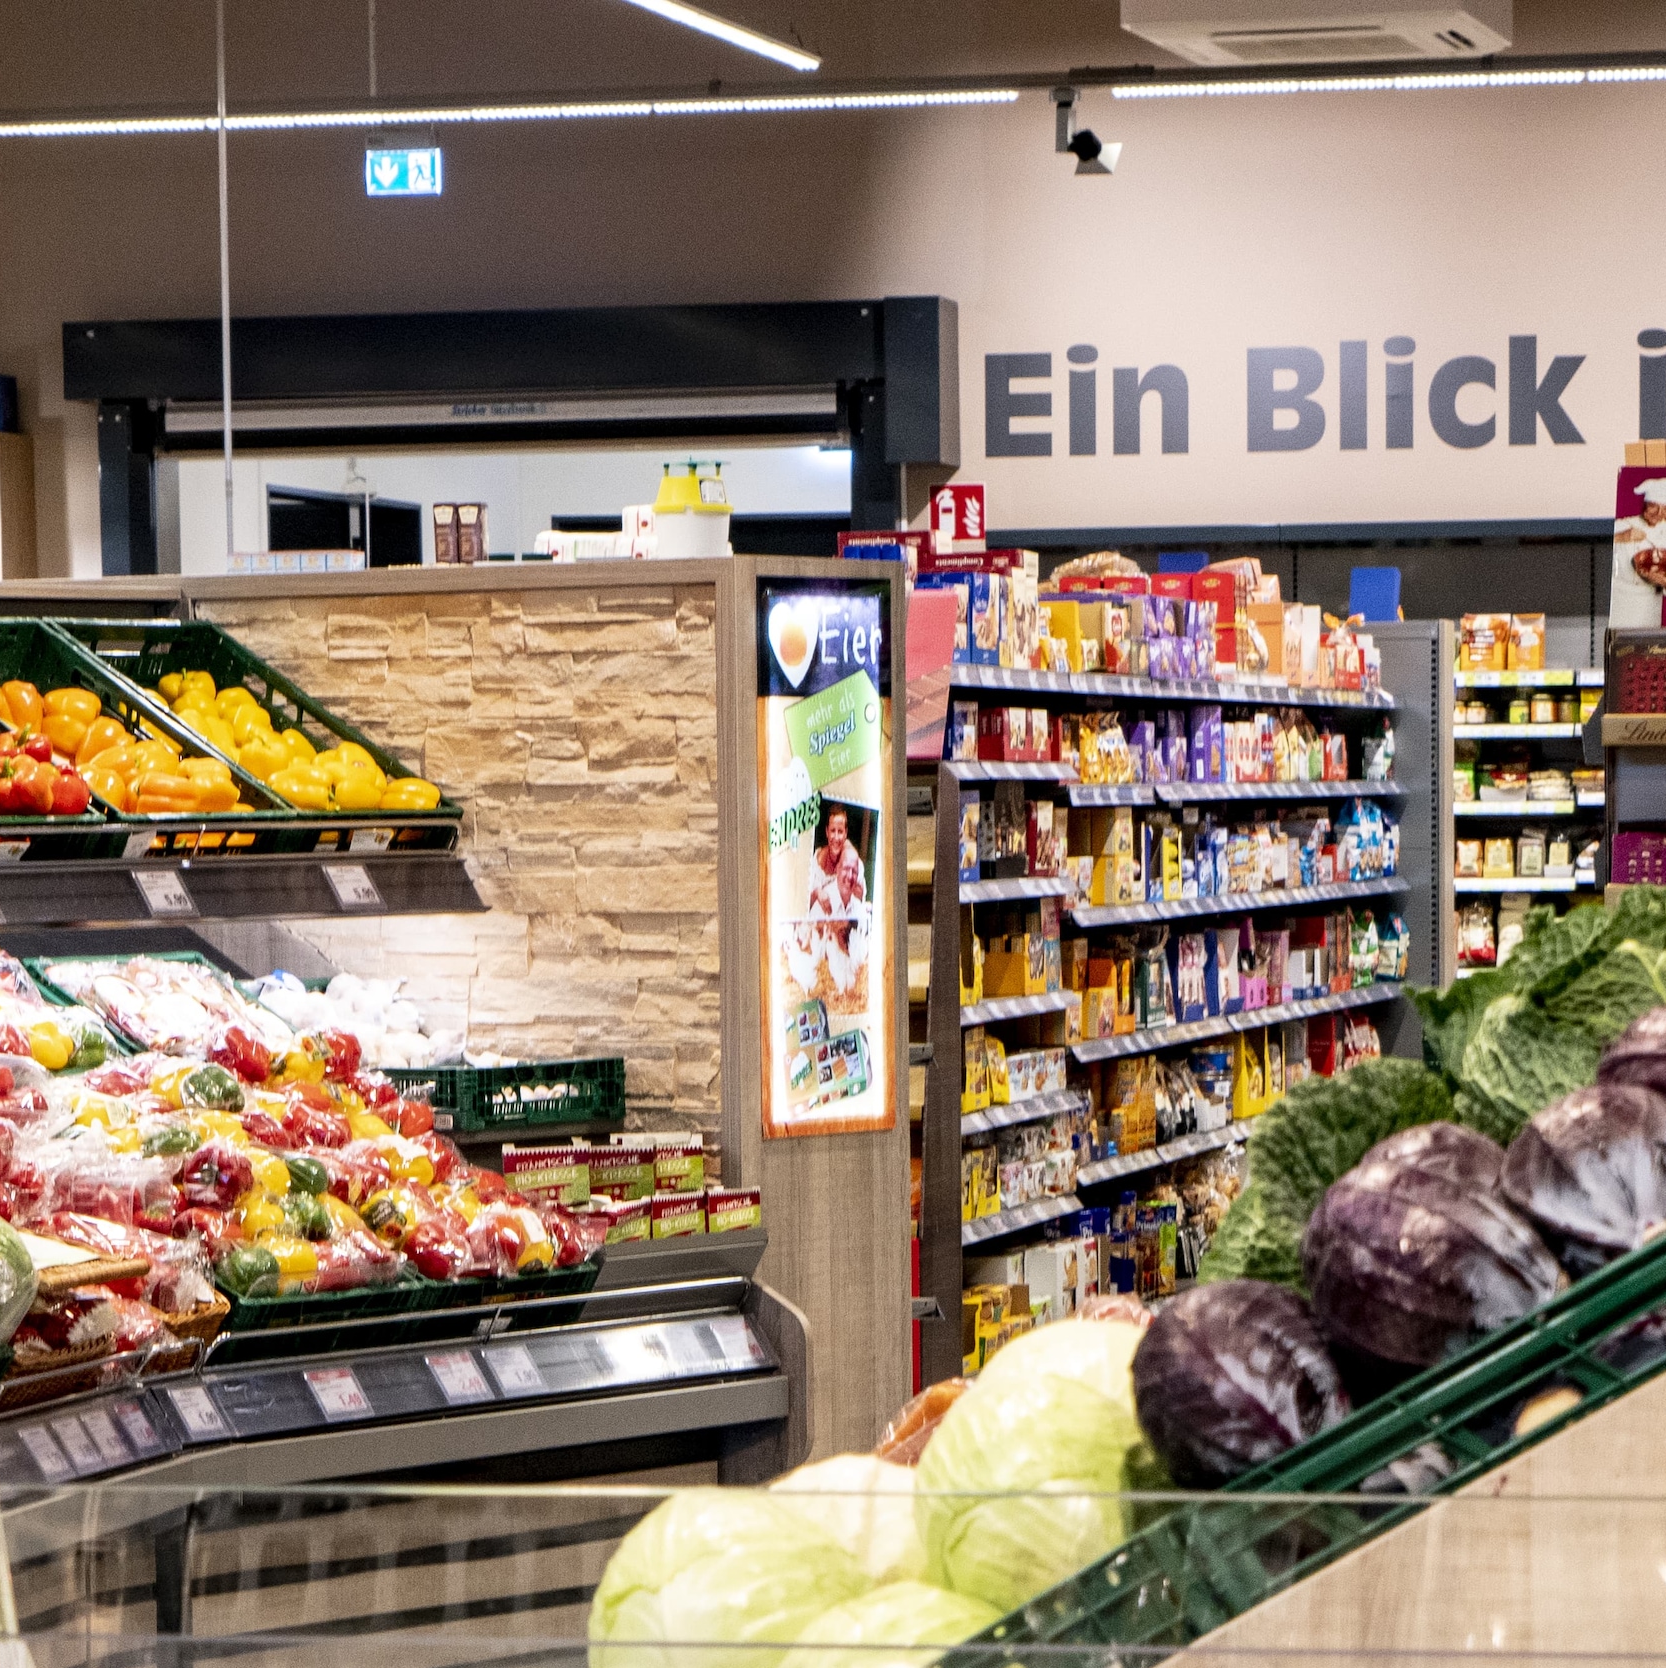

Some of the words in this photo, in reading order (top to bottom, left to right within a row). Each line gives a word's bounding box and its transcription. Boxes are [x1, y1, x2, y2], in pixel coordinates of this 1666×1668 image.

[984, 343, 1189, 456] Ein
[1246, 334, 1587, 453] Blick
[819, 605, 883, 665] Eier
[806, 702, 833, 728] mehr
[839, 689, 856, 710] als
[808, 711, 856, 757] Spiegel
[828, 748, 851, 773] Eier
[770, 790, 823, 850] ENDRES
[515, 1168, 577, 1186] BIO-KRESSE
[516, 1155, 575, 1172] FRÄNKISCHE
